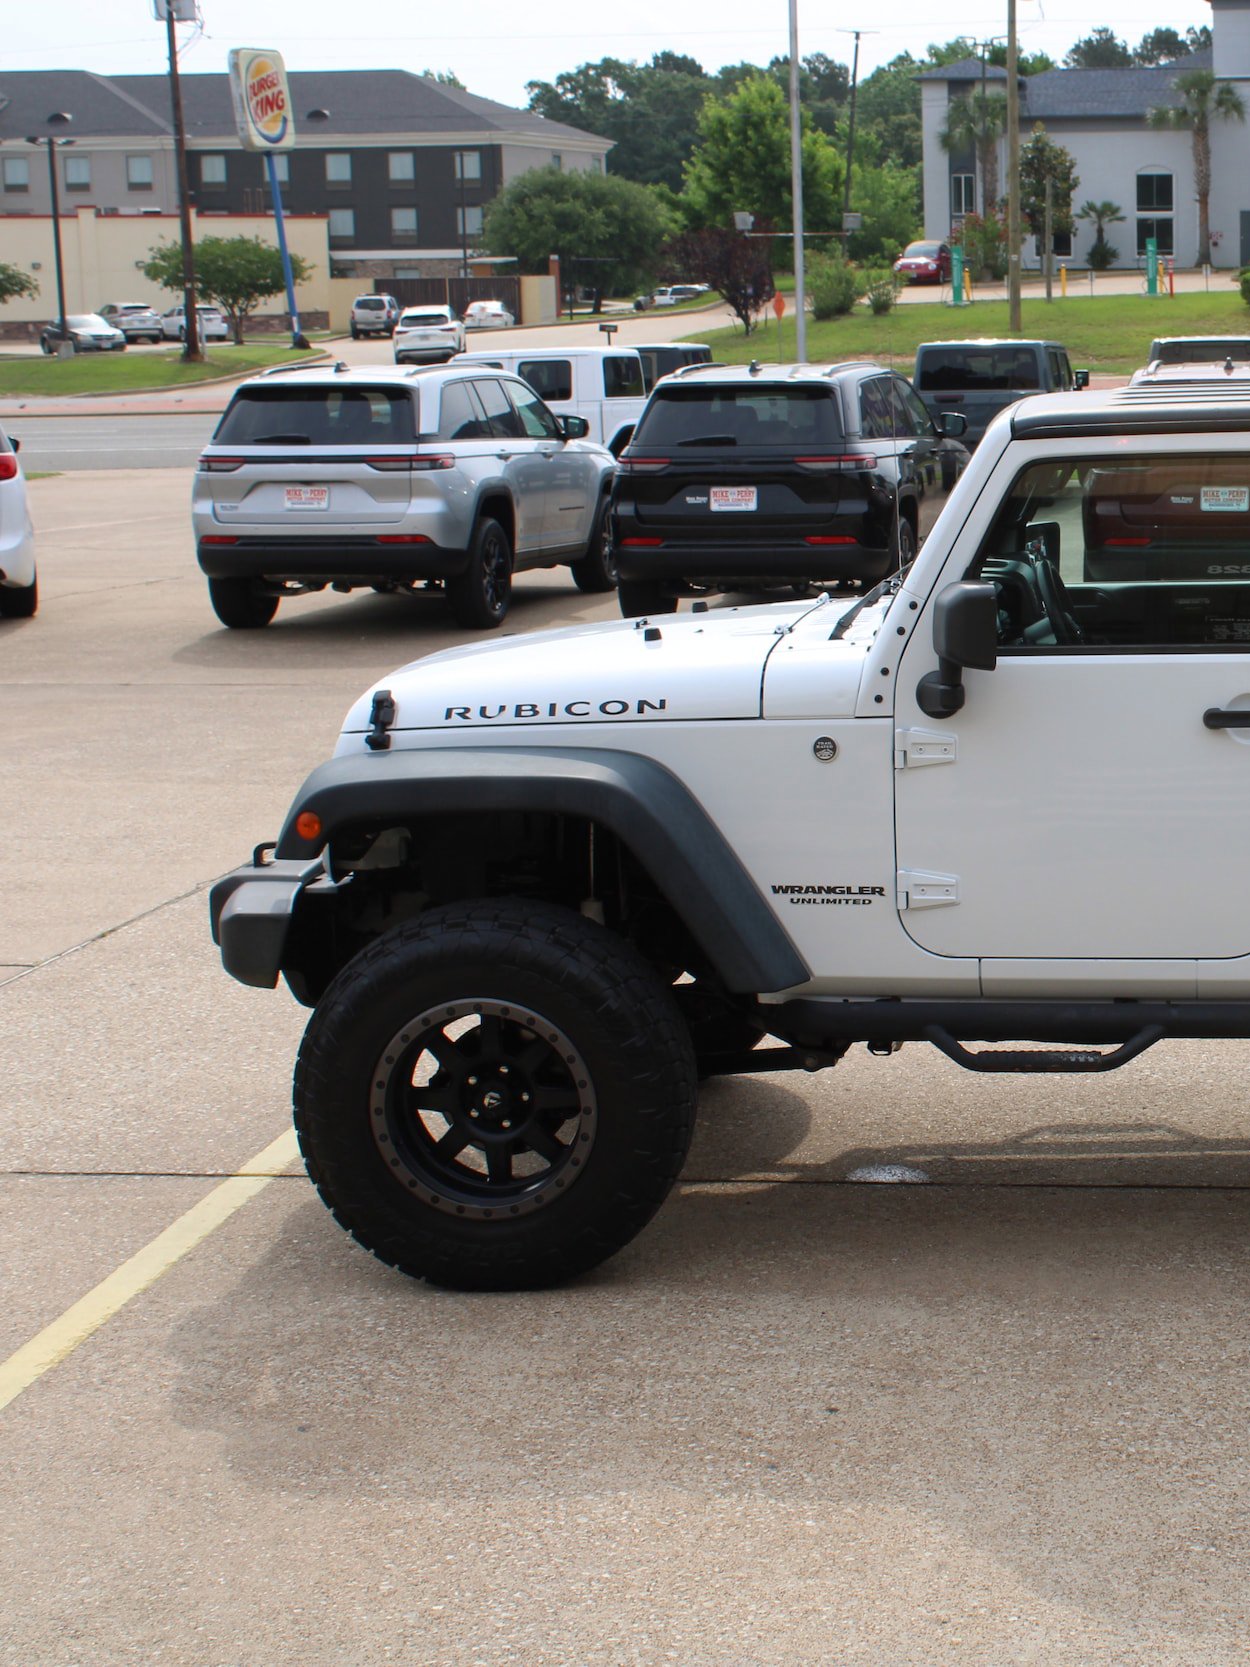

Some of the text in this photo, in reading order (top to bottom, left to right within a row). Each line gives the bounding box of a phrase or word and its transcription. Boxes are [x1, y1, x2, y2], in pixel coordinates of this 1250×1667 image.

[253, 89, 285, 122] KING
[712, 490, 755, 498] MIKE PERRY
[1202, 490, 1247, 498] MIKE PERRY
[444, 699, 667, 721] RUBICON
[771, 885, 886, 897] WRANGLER
